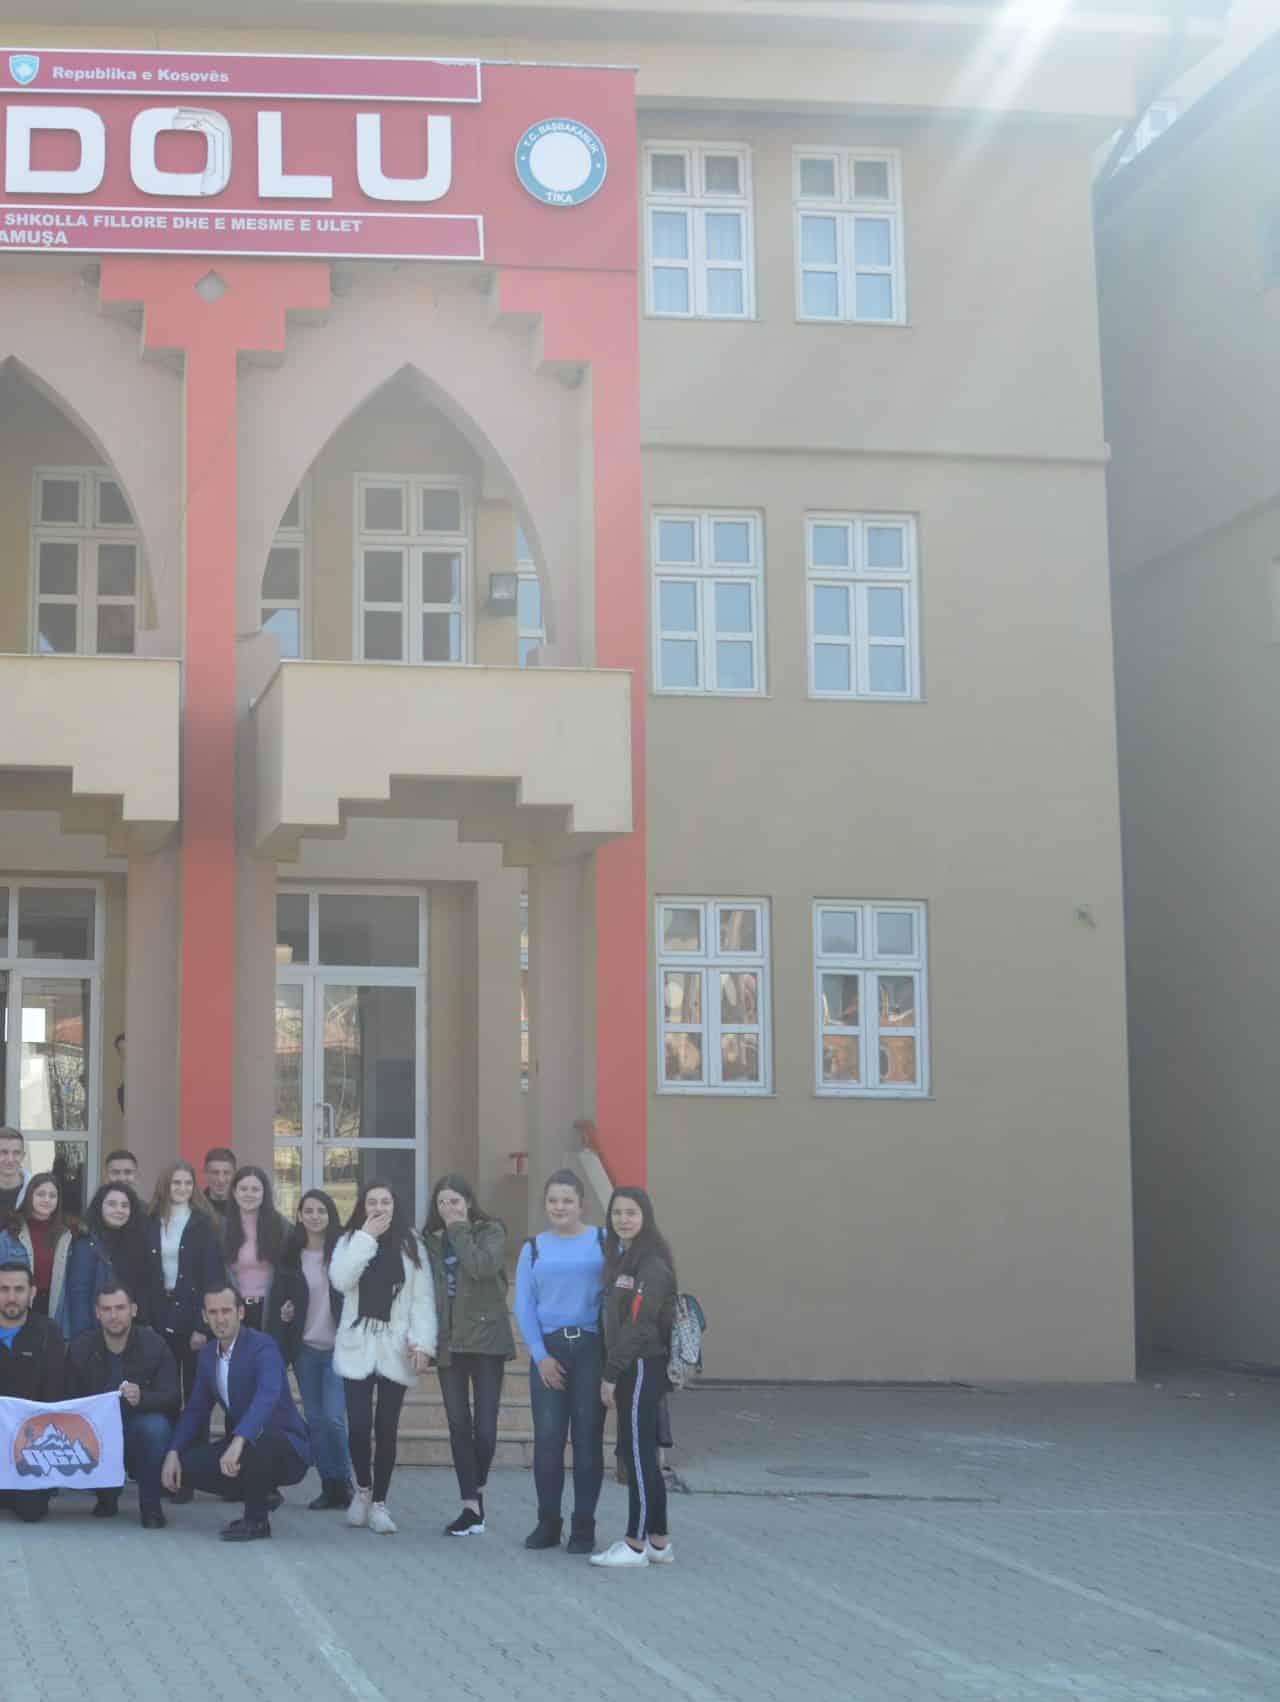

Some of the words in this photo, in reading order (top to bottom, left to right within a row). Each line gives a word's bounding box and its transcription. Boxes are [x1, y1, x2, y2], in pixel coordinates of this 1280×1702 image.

[52, 65, 136, 82] Republika
[142, 71, 152, 80] e
[158, 68, 229, 83] Kosovës
[4, 212, 88, 227] SHKOLLA
[93, 214, 168, 229] FILLORE
[173, 217, 209, 230] DHE
[215, 218, 225, 230] E
[231, 217, 295, 232] MESME
[301, 219, 311, 232] E
[319, 219, 363, 233] ULET
